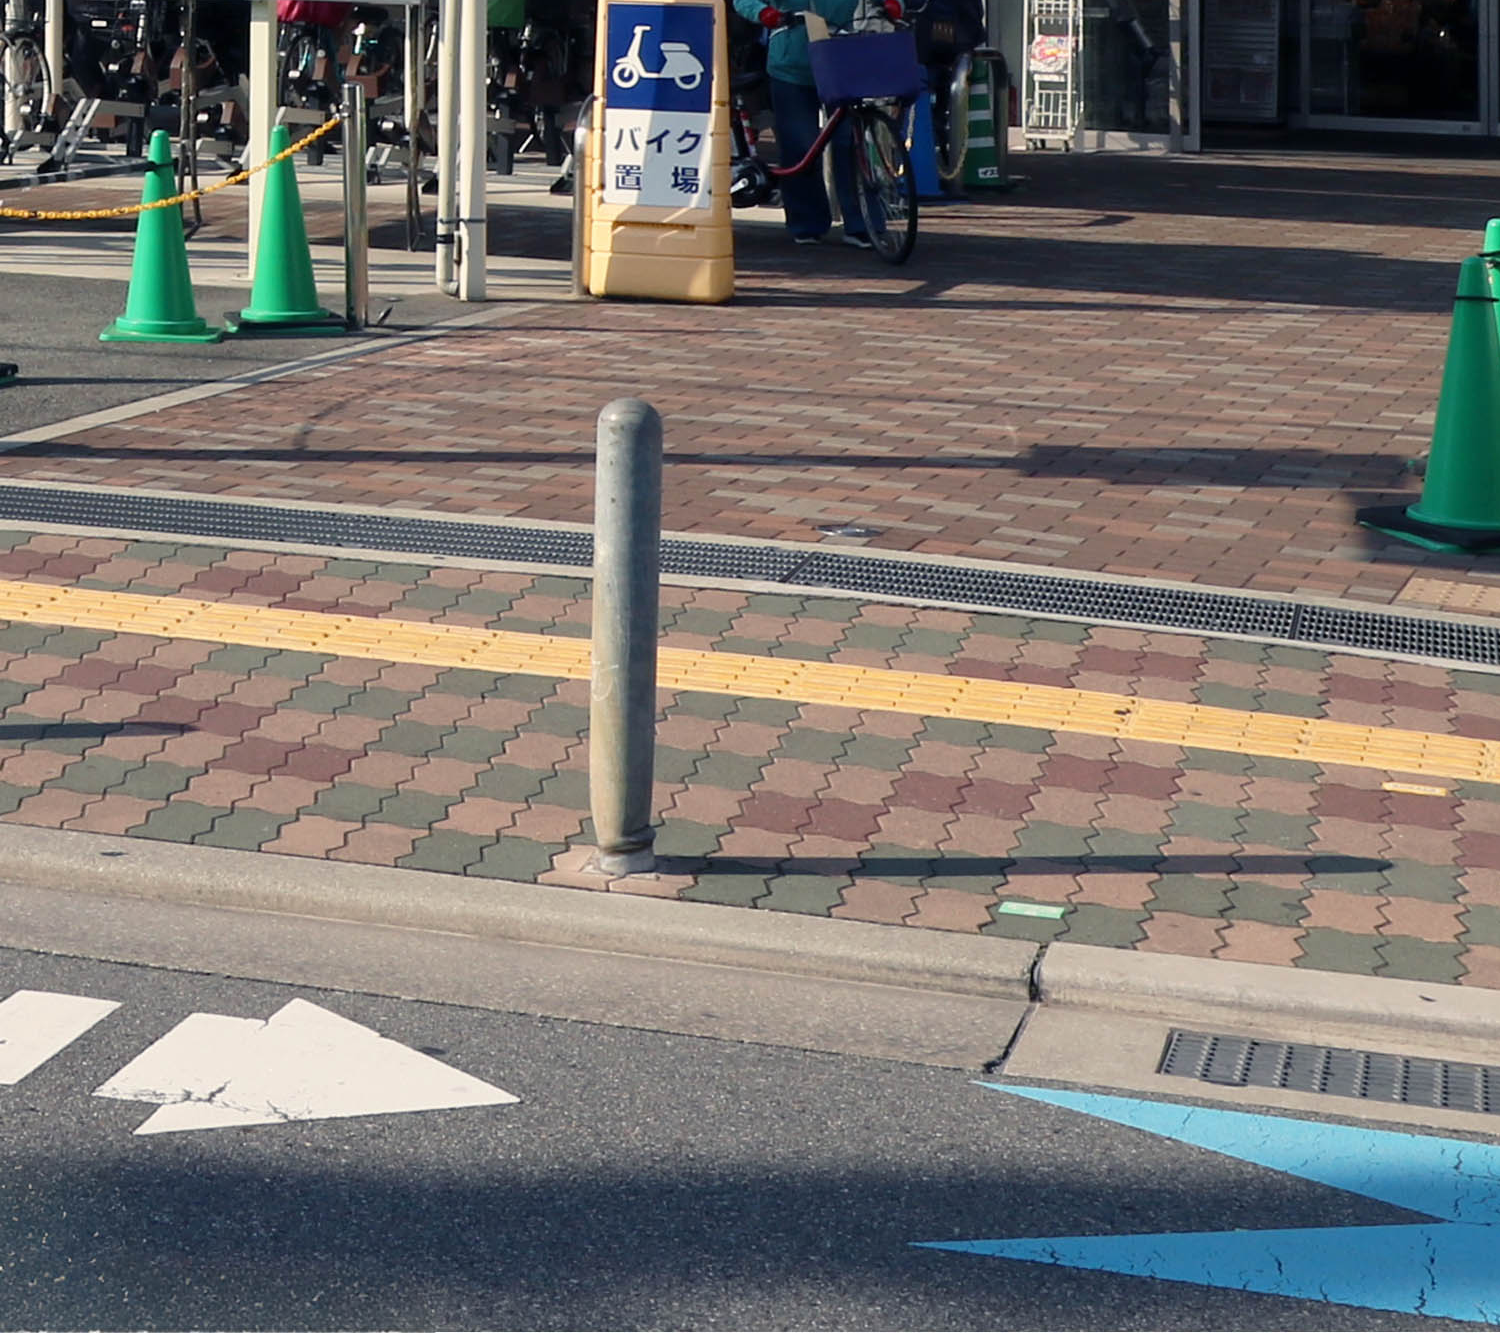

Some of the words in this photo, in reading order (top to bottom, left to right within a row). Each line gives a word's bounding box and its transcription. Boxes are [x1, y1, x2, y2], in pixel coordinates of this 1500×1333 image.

[614, 126, 702, 155] バイク
[615, 164, 701, 194] 置場
